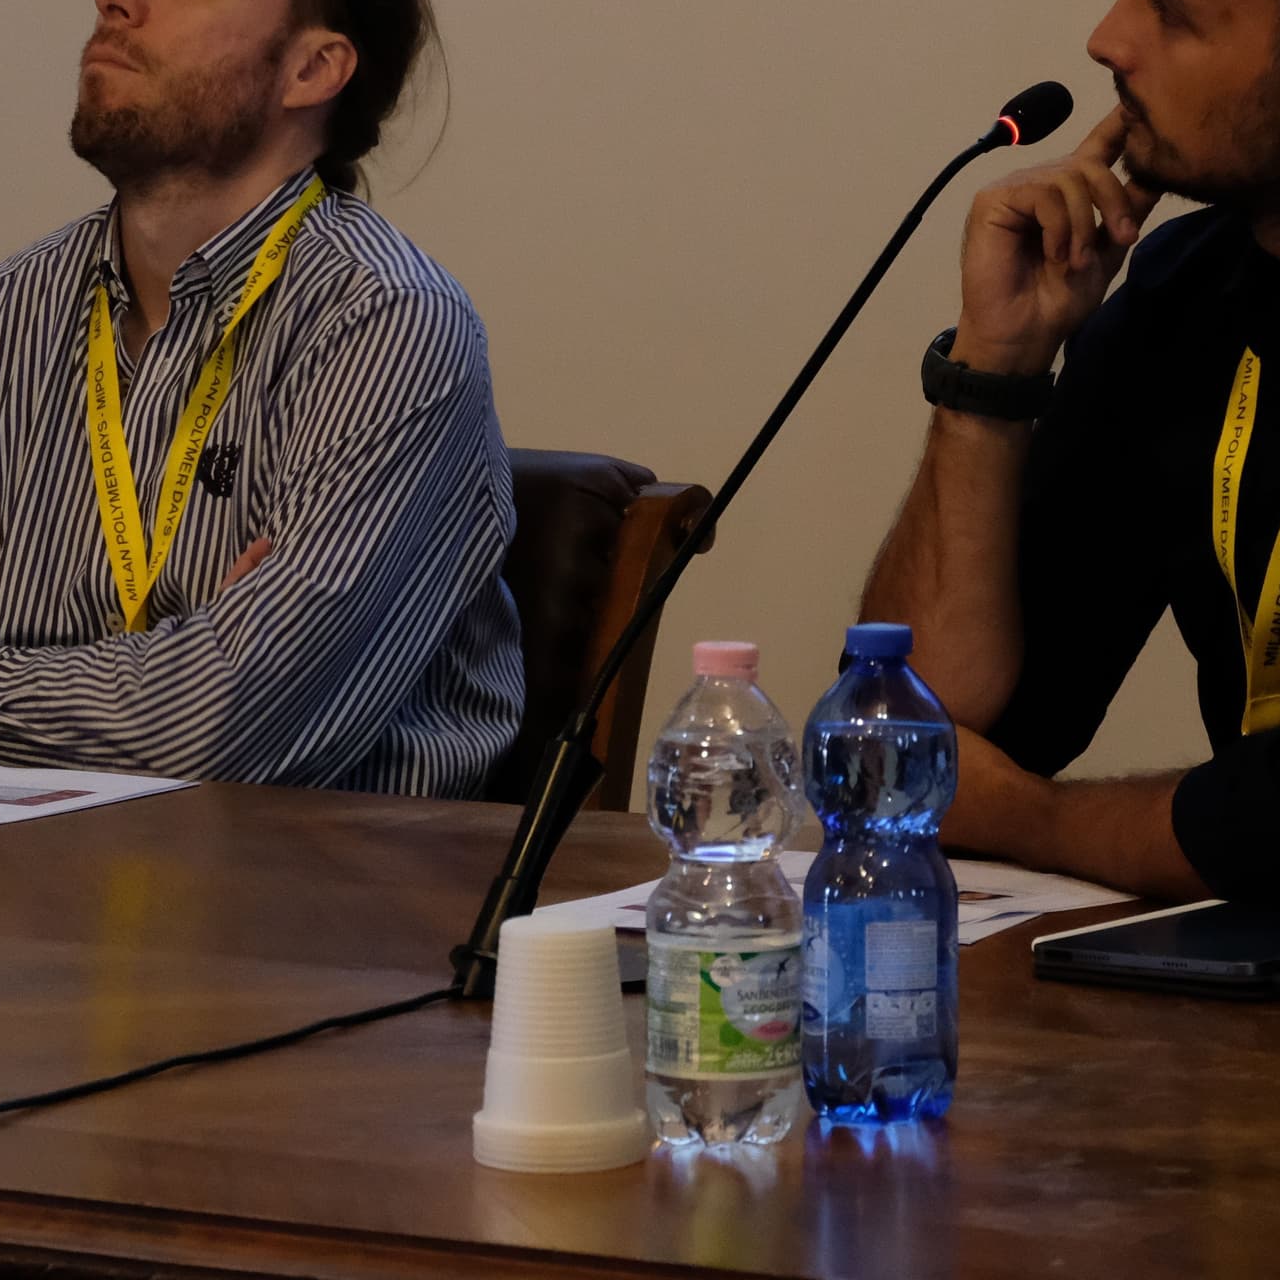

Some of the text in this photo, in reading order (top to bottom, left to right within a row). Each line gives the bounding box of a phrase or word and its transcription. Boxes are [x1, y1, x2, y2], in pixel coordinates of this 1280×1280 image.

[266, 224, 299, 261] DAYS
[94, 361, 107, 411] MIPOL
[206, 346, 225, 402] MILAN
[1236, 357, 1254, 420] MILAN
[97, 420, 114, 464] DAYS
[177, 404, 212, 487] POLYMER
[1221, 426, 1243, 524] POLYMER
[104, 470, 128, 545] POLYMER
[163, 489, 184, 537] DAYS
[119, 549, 138, 601] MILAN
